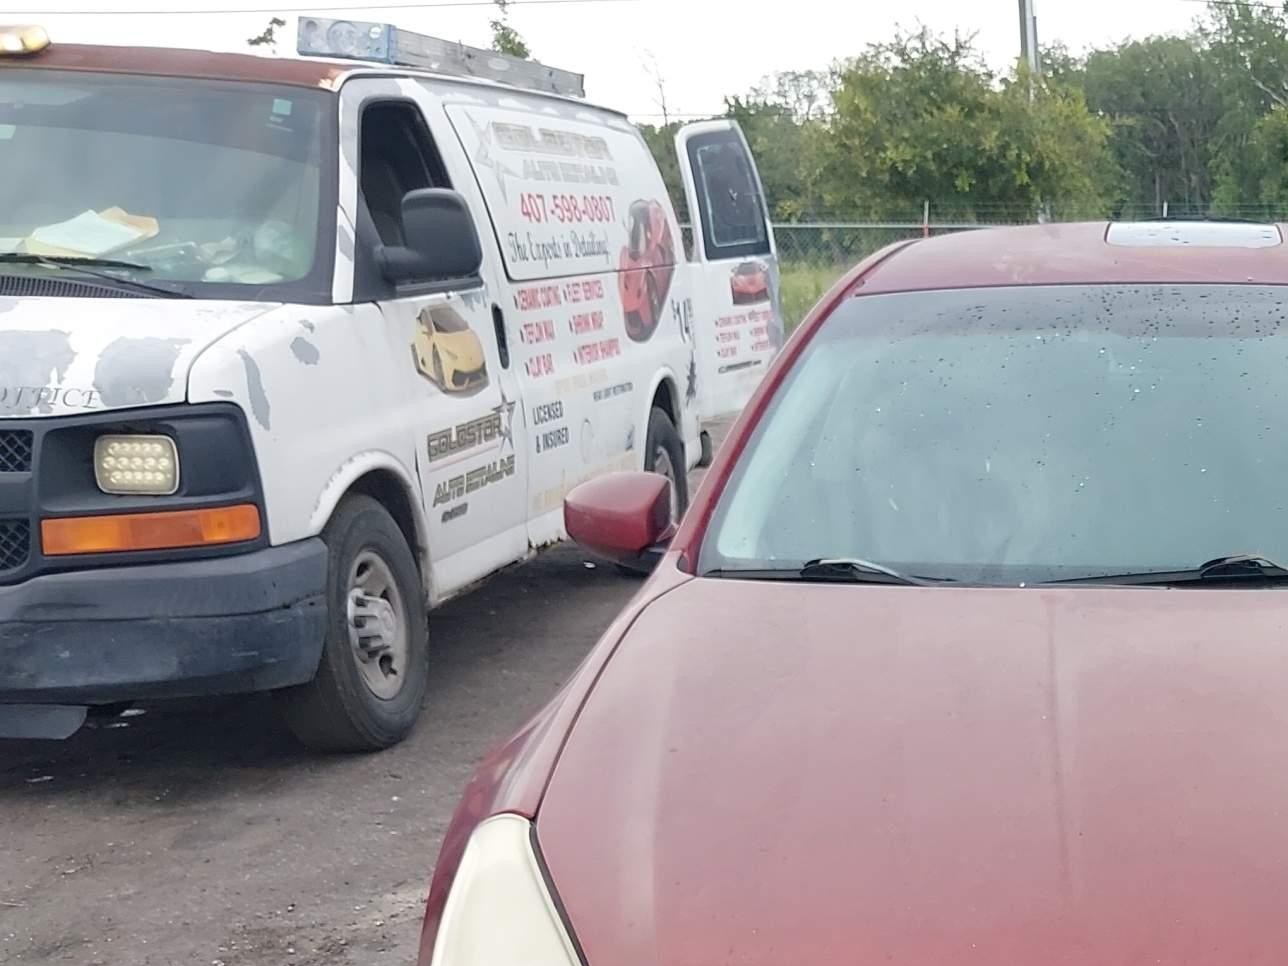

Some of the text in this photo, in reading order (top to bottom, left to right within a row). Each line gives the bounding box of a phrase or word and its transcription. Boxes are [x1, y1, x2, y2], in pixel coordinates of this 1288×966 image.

[520, 191, 616, 224] 407-598-0807
[508, 231, 528, 263] The
[527, 232, 562, 269] Experts
[562, 234, 573, 259] in
[532, 400, 563, 426] LICENSED
[536, 426, 569, 454] & INSURED
